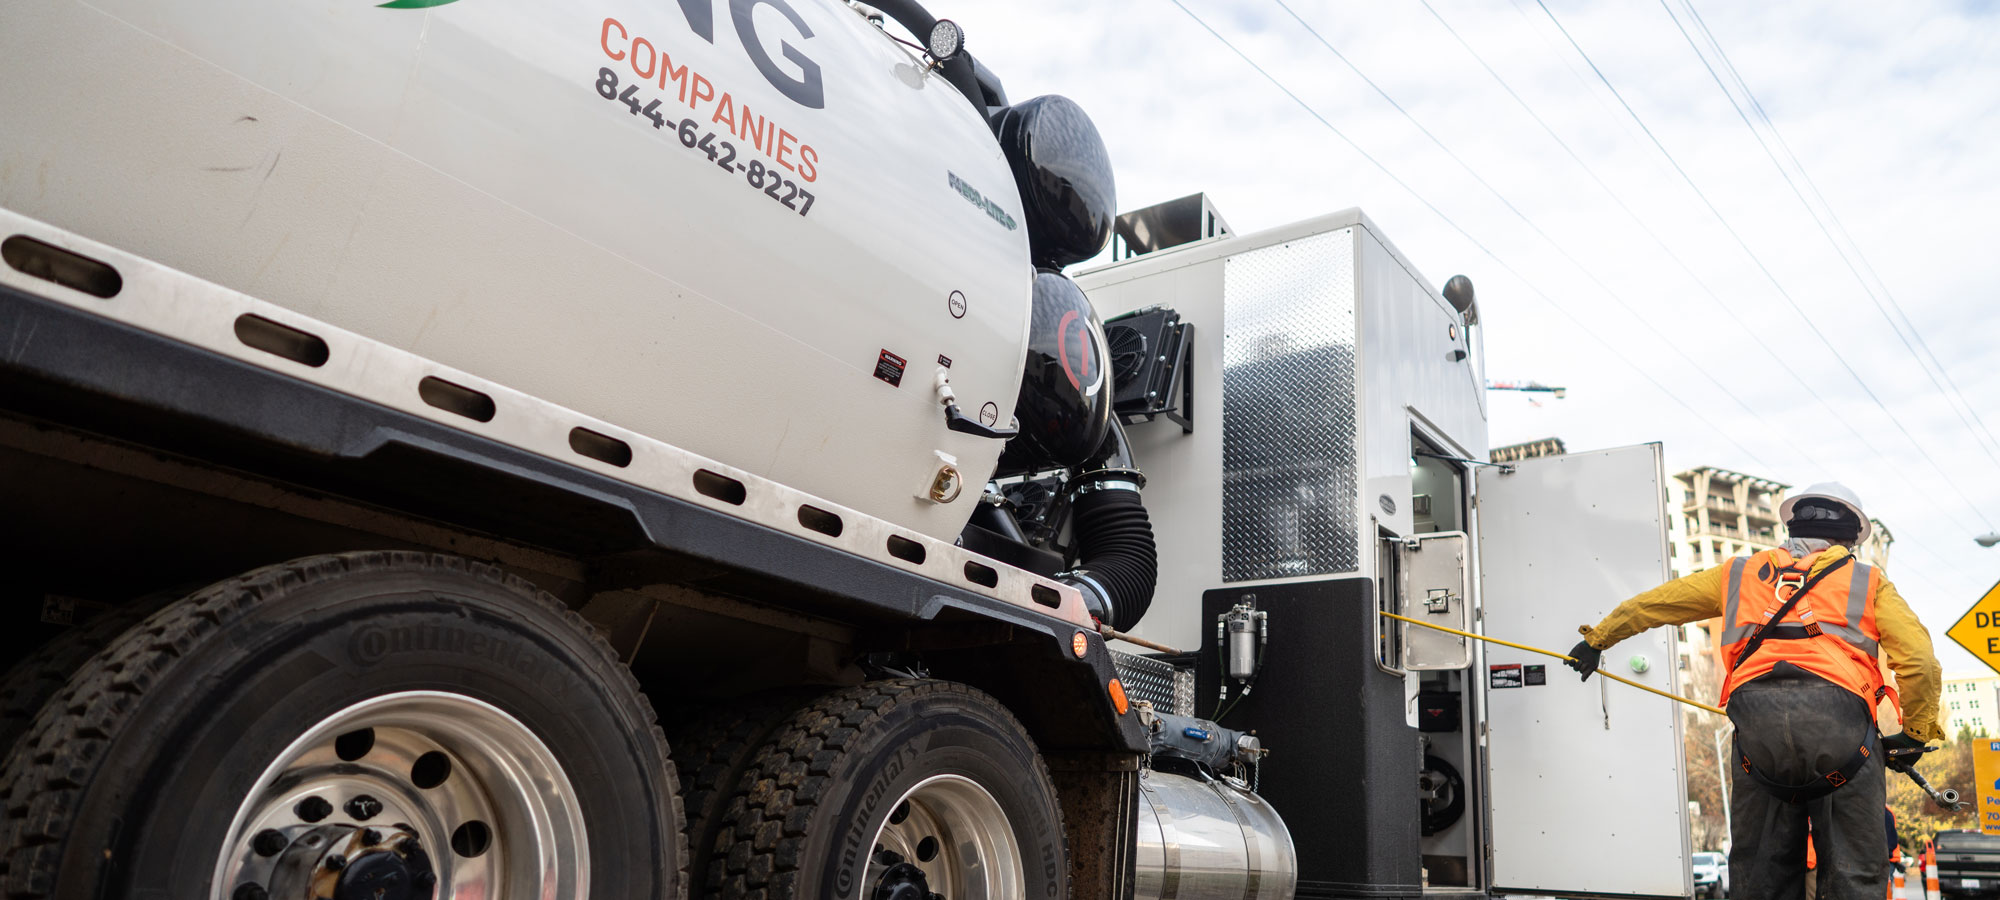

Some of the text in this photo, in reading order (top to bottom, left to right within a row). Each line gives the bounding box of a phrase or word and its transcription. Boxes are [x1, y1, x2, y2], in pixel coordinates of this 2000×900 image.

[601, 17, 818, 182] COMPANIES
[595, 67, 815, 217] 844-642-8227
[951, 298, 964, 310] OPEN
[982, 409, 996, 421] CLOSE
[347, 617, 549, 685] Continental
[1987, 637, 2000, 654] E
[833, 747, 905, 899] Continental
